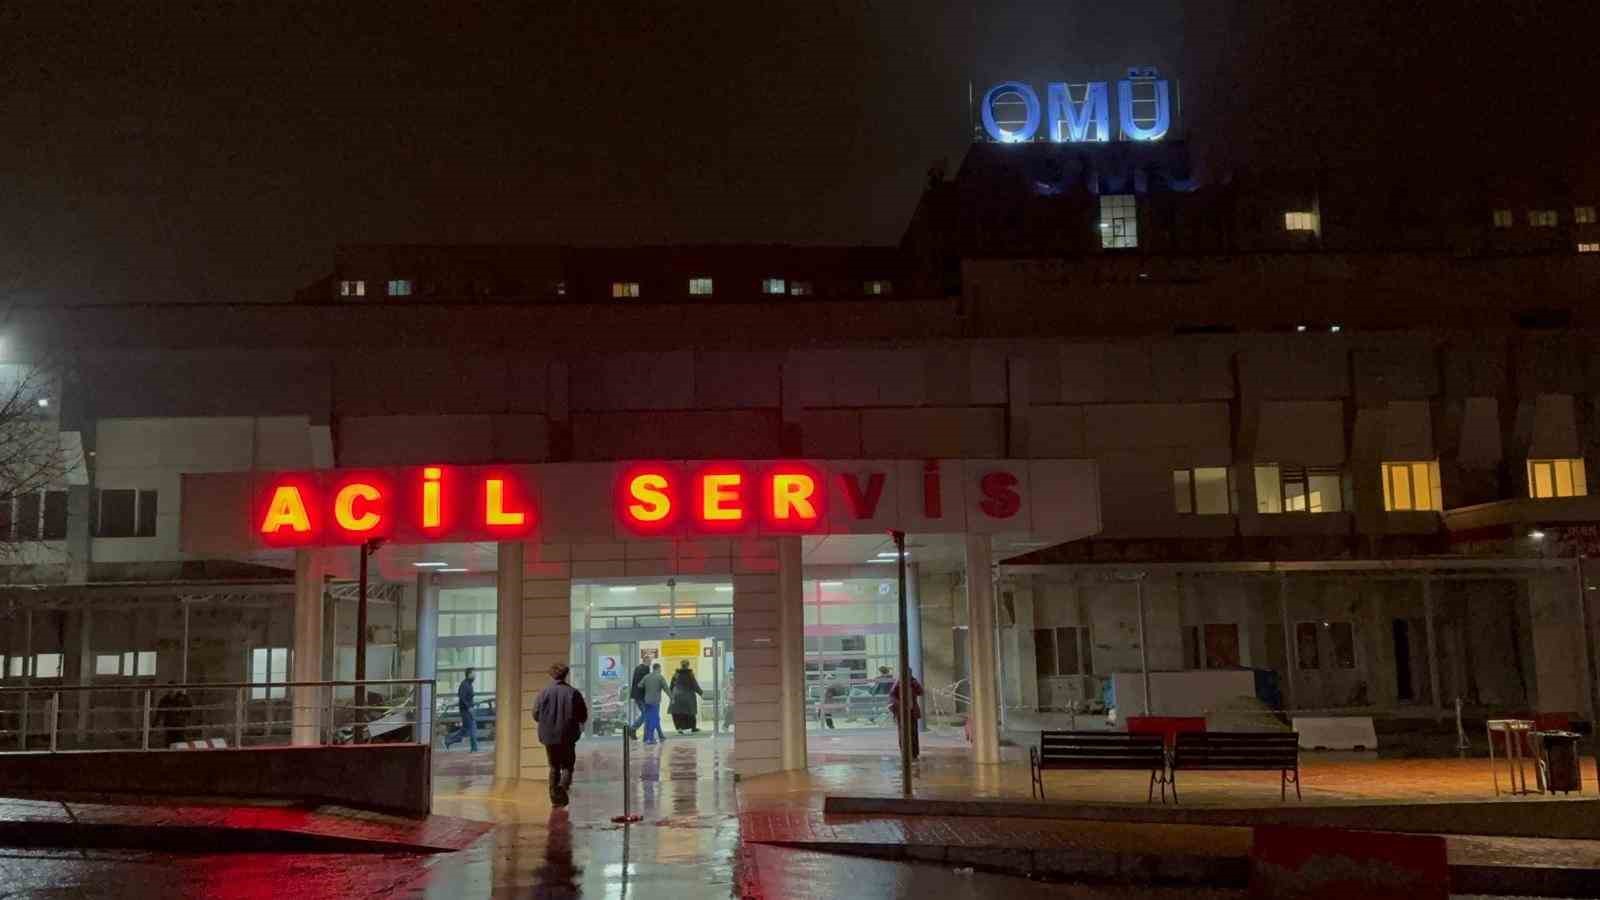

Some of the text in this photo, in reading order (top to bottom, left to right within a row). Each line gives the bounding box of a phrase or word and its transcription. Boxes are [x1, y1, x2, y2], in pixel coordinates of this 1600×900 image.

[981, 66, 1170, 142] OMÜ
[261, 460, 1021, 533] ACİL SERVİS
